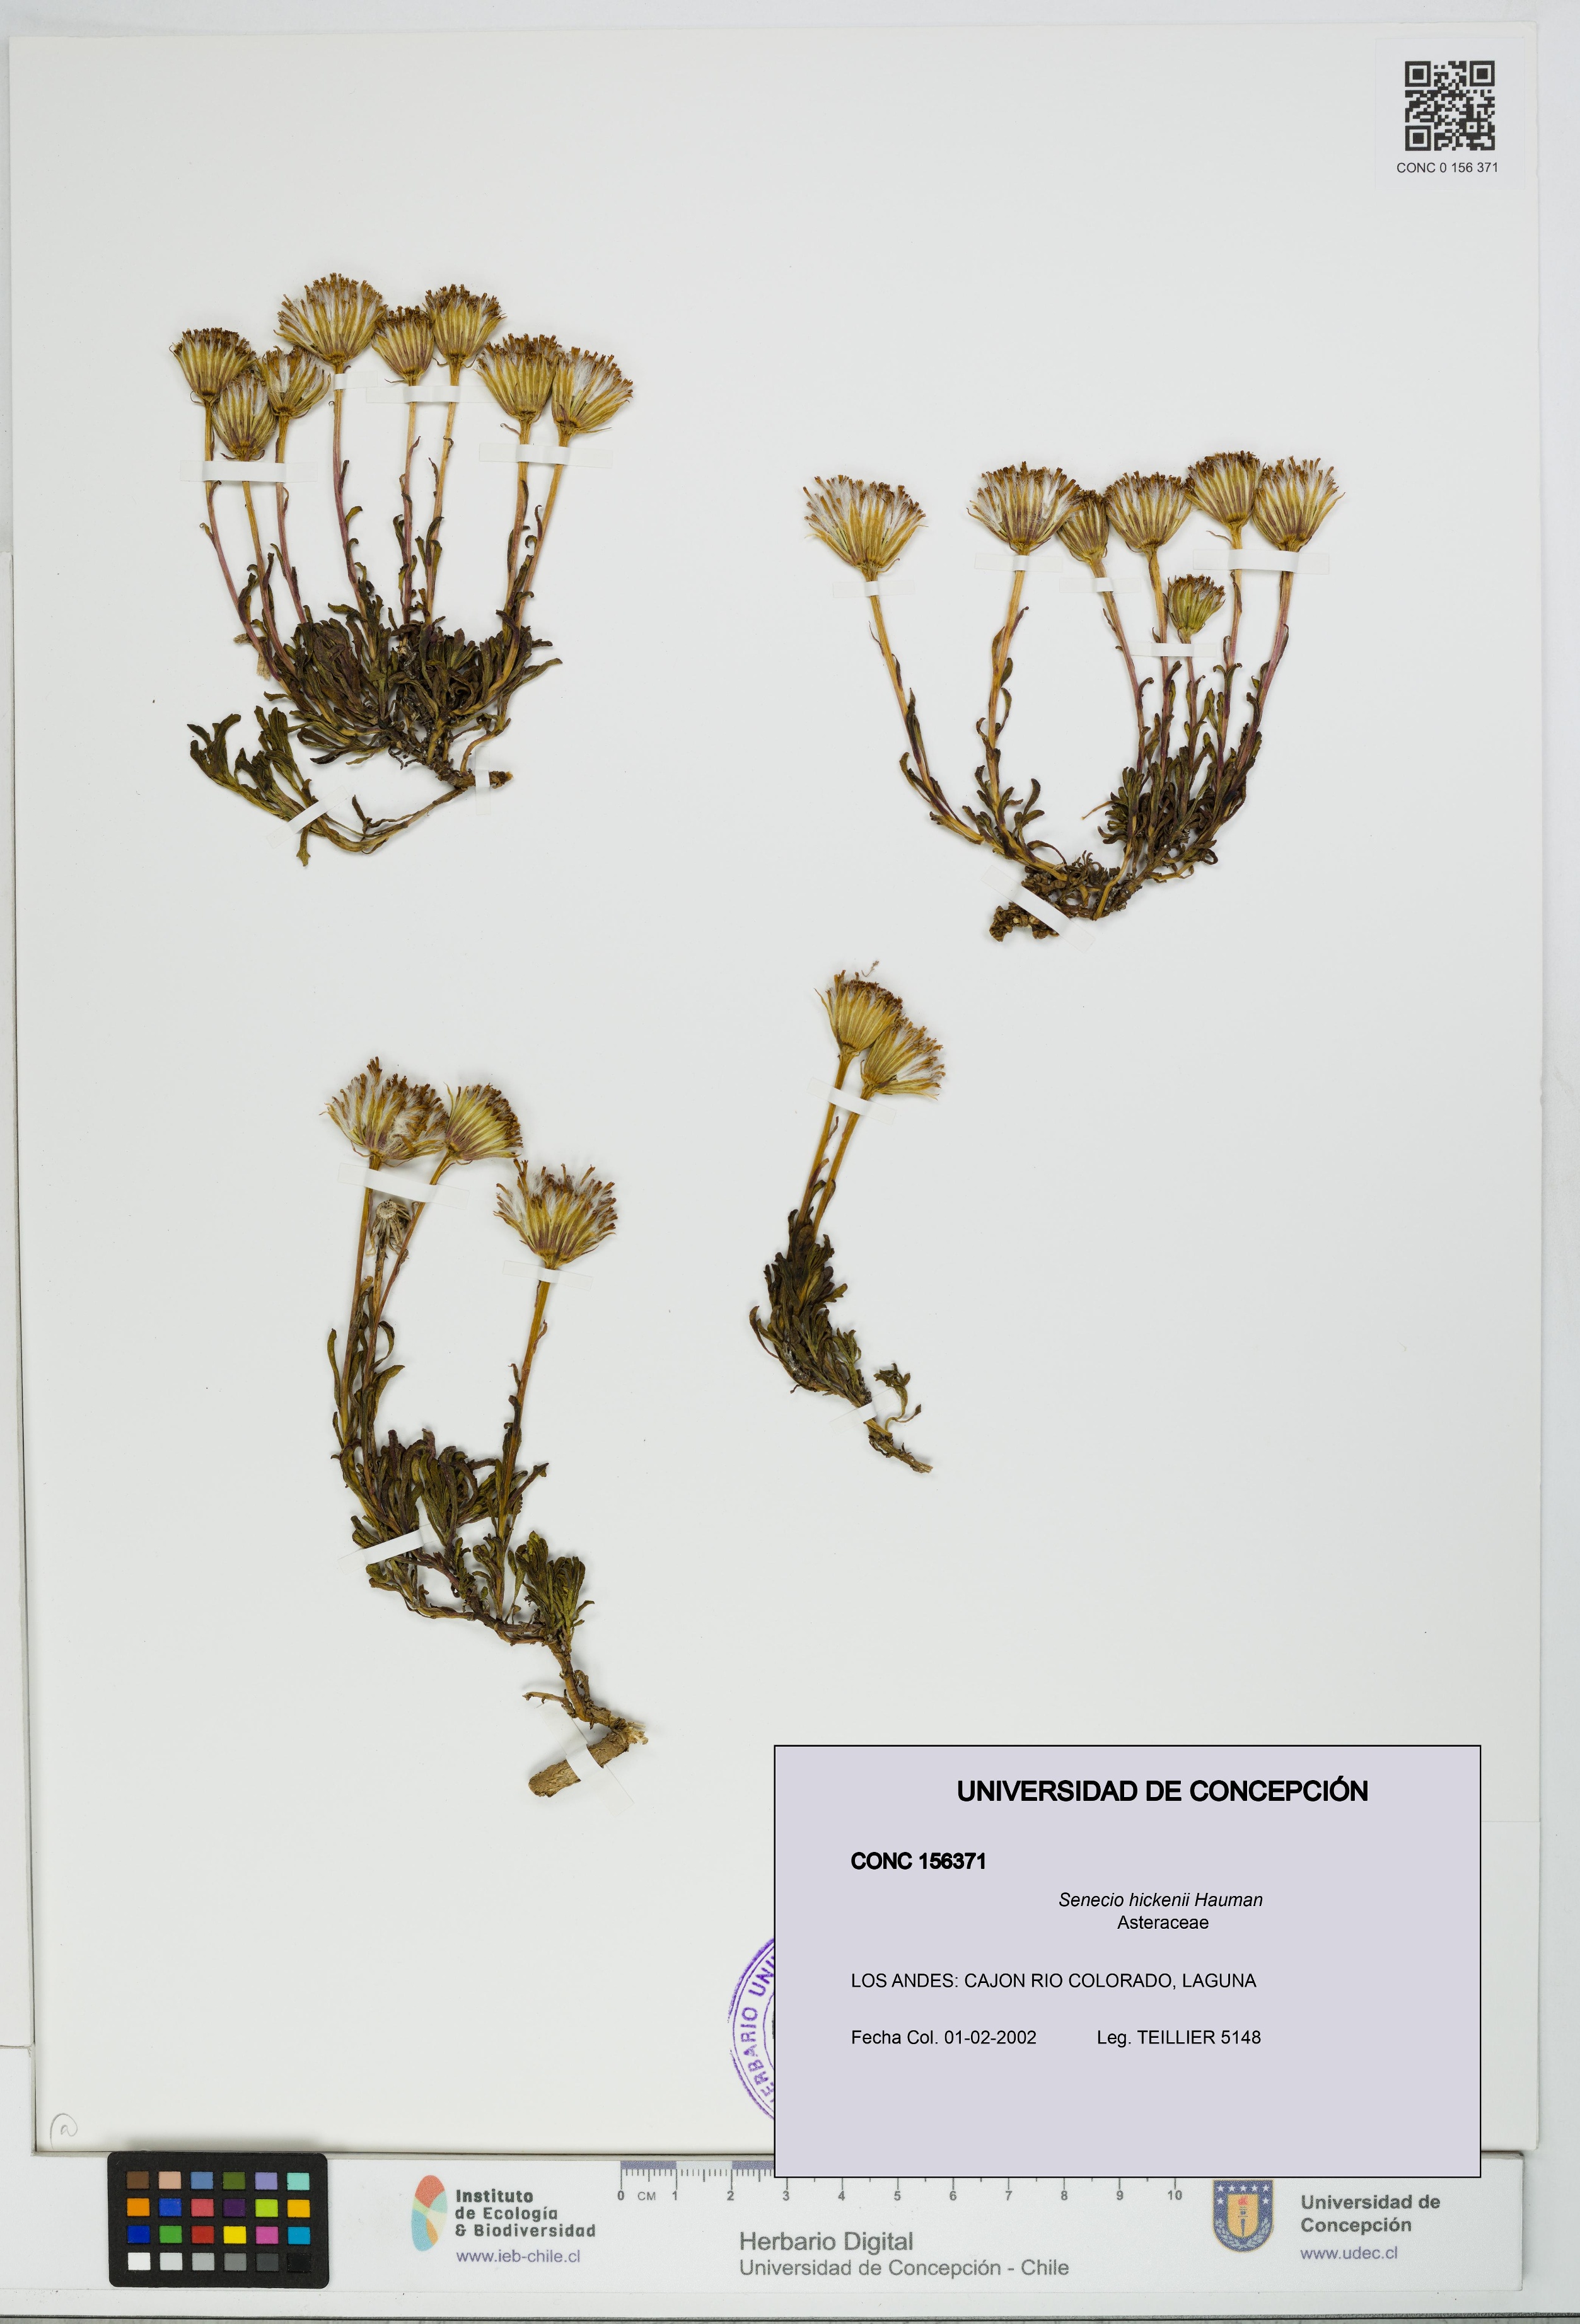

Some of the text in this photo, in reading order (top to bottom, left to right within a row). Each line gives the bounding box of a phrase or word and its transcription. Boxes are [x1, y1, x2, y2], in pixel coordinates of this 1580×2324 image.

[1397, 161, 1497, 173] CONC 0 156 371
[741, 2006, 774, 2103] ERBARIO
[456, 2188, 533, 2204] Instituto
[617, 2190, 1183, 2201] 0 CM 1 2 3 4 5 6 7 8 9 10
[1301, 2194, 1441, 2210] Universidad de
[455, 2205, 558, 2223] de Ecología
[455, 2223, 596, 2238] & Biodiversidad
[1301, 2216, 1412, 2236] Concepción
[740, 2231, 913, 2256] Herbario Digital
[456, 2249, 581, 2263] www.ieb-chile.cl
[1300, 2245, 1398, 2260] www.udec.cl
[740, 2259, 851, 2276] Universidad
[858, 2259, 882, 2276] de
[888, 2259, 1001, 2280] Concepción
[1021, 2258, 1069, 2276] Chile
